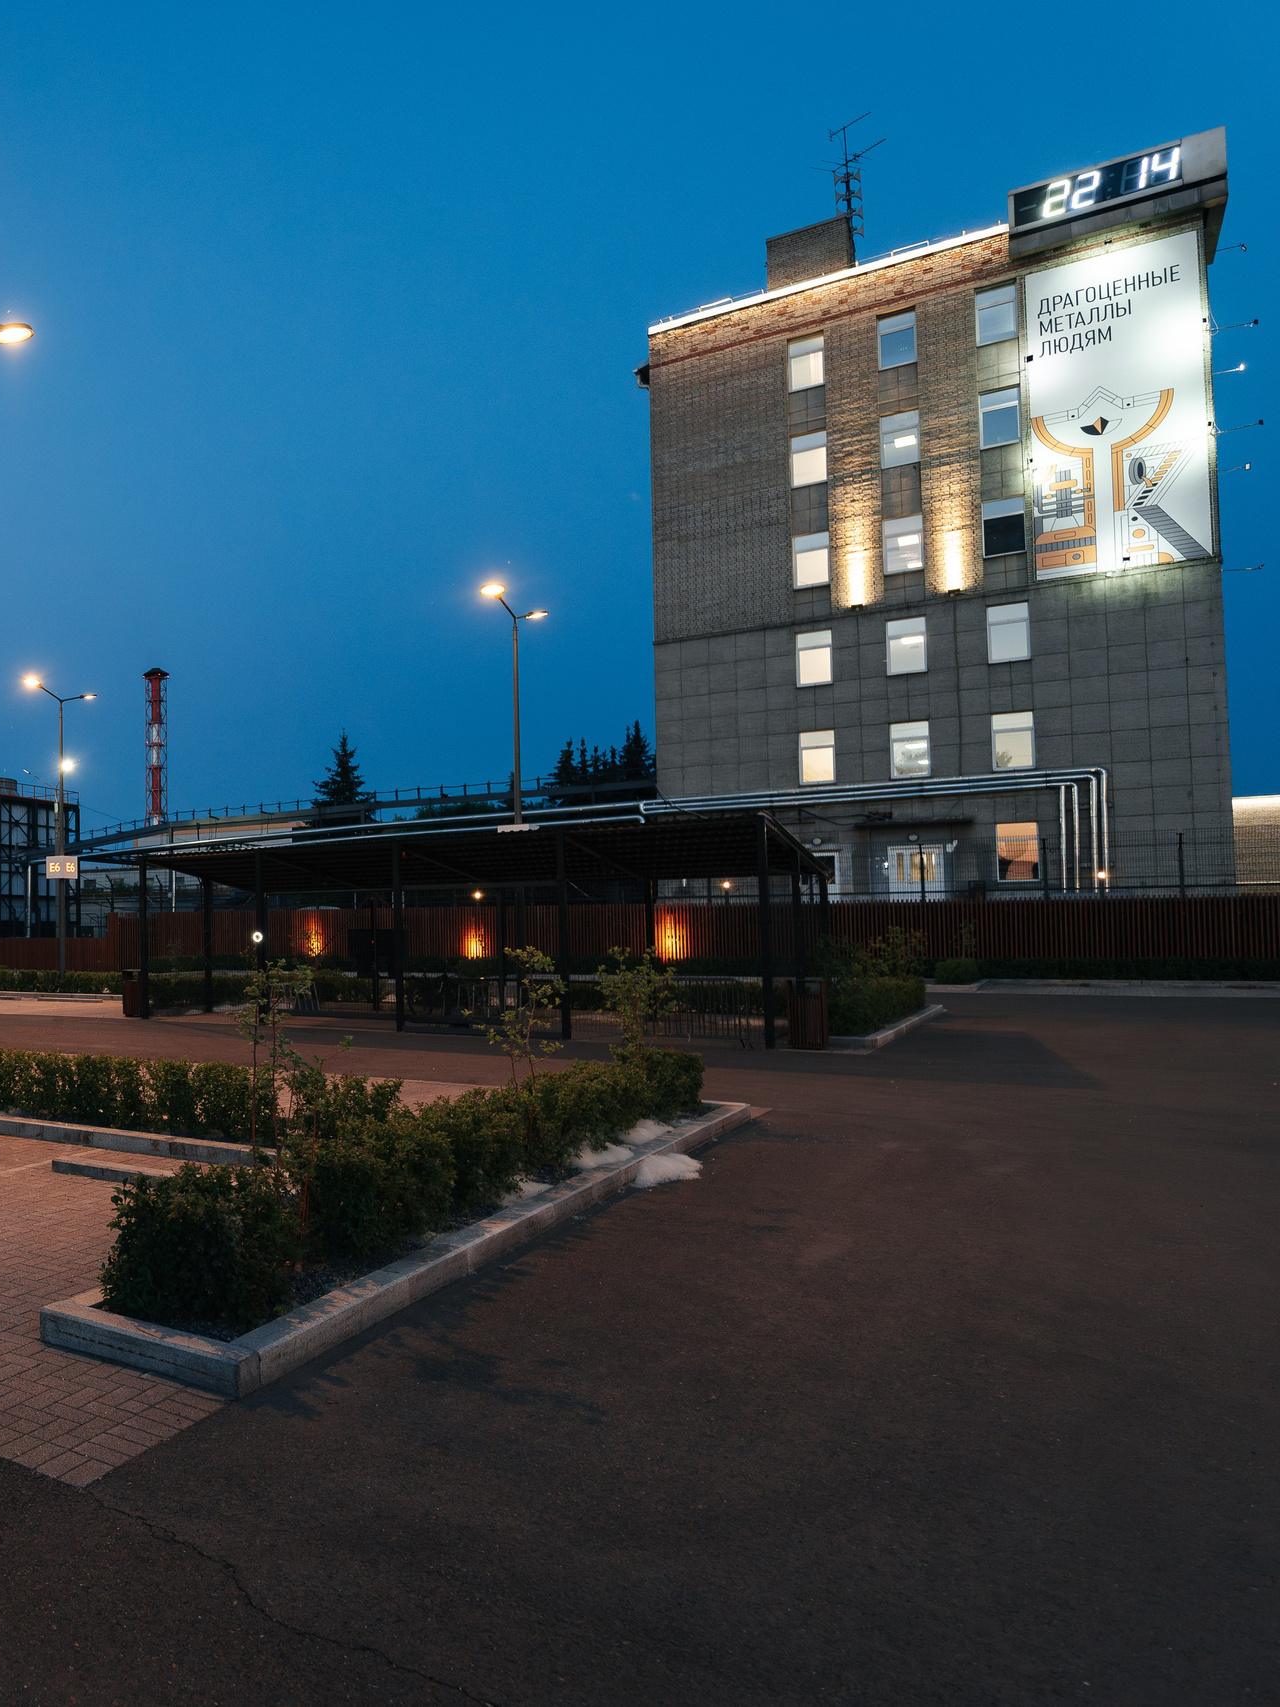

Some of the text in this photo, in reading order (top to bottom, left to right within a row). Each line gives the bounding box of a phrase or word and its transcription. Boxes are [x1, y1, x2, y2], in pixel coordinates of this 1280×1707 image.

[1038, 264, 1180, 318] ДРАГОЦЕННЫЕ
[1039, 299, 1132, 336] МЕТАЛЛЫ
[1040, 326, 1112, 357] ЛЮДЯМ
[49, 862, 61, 873] E6
[66, 862, 75, 873] E6
